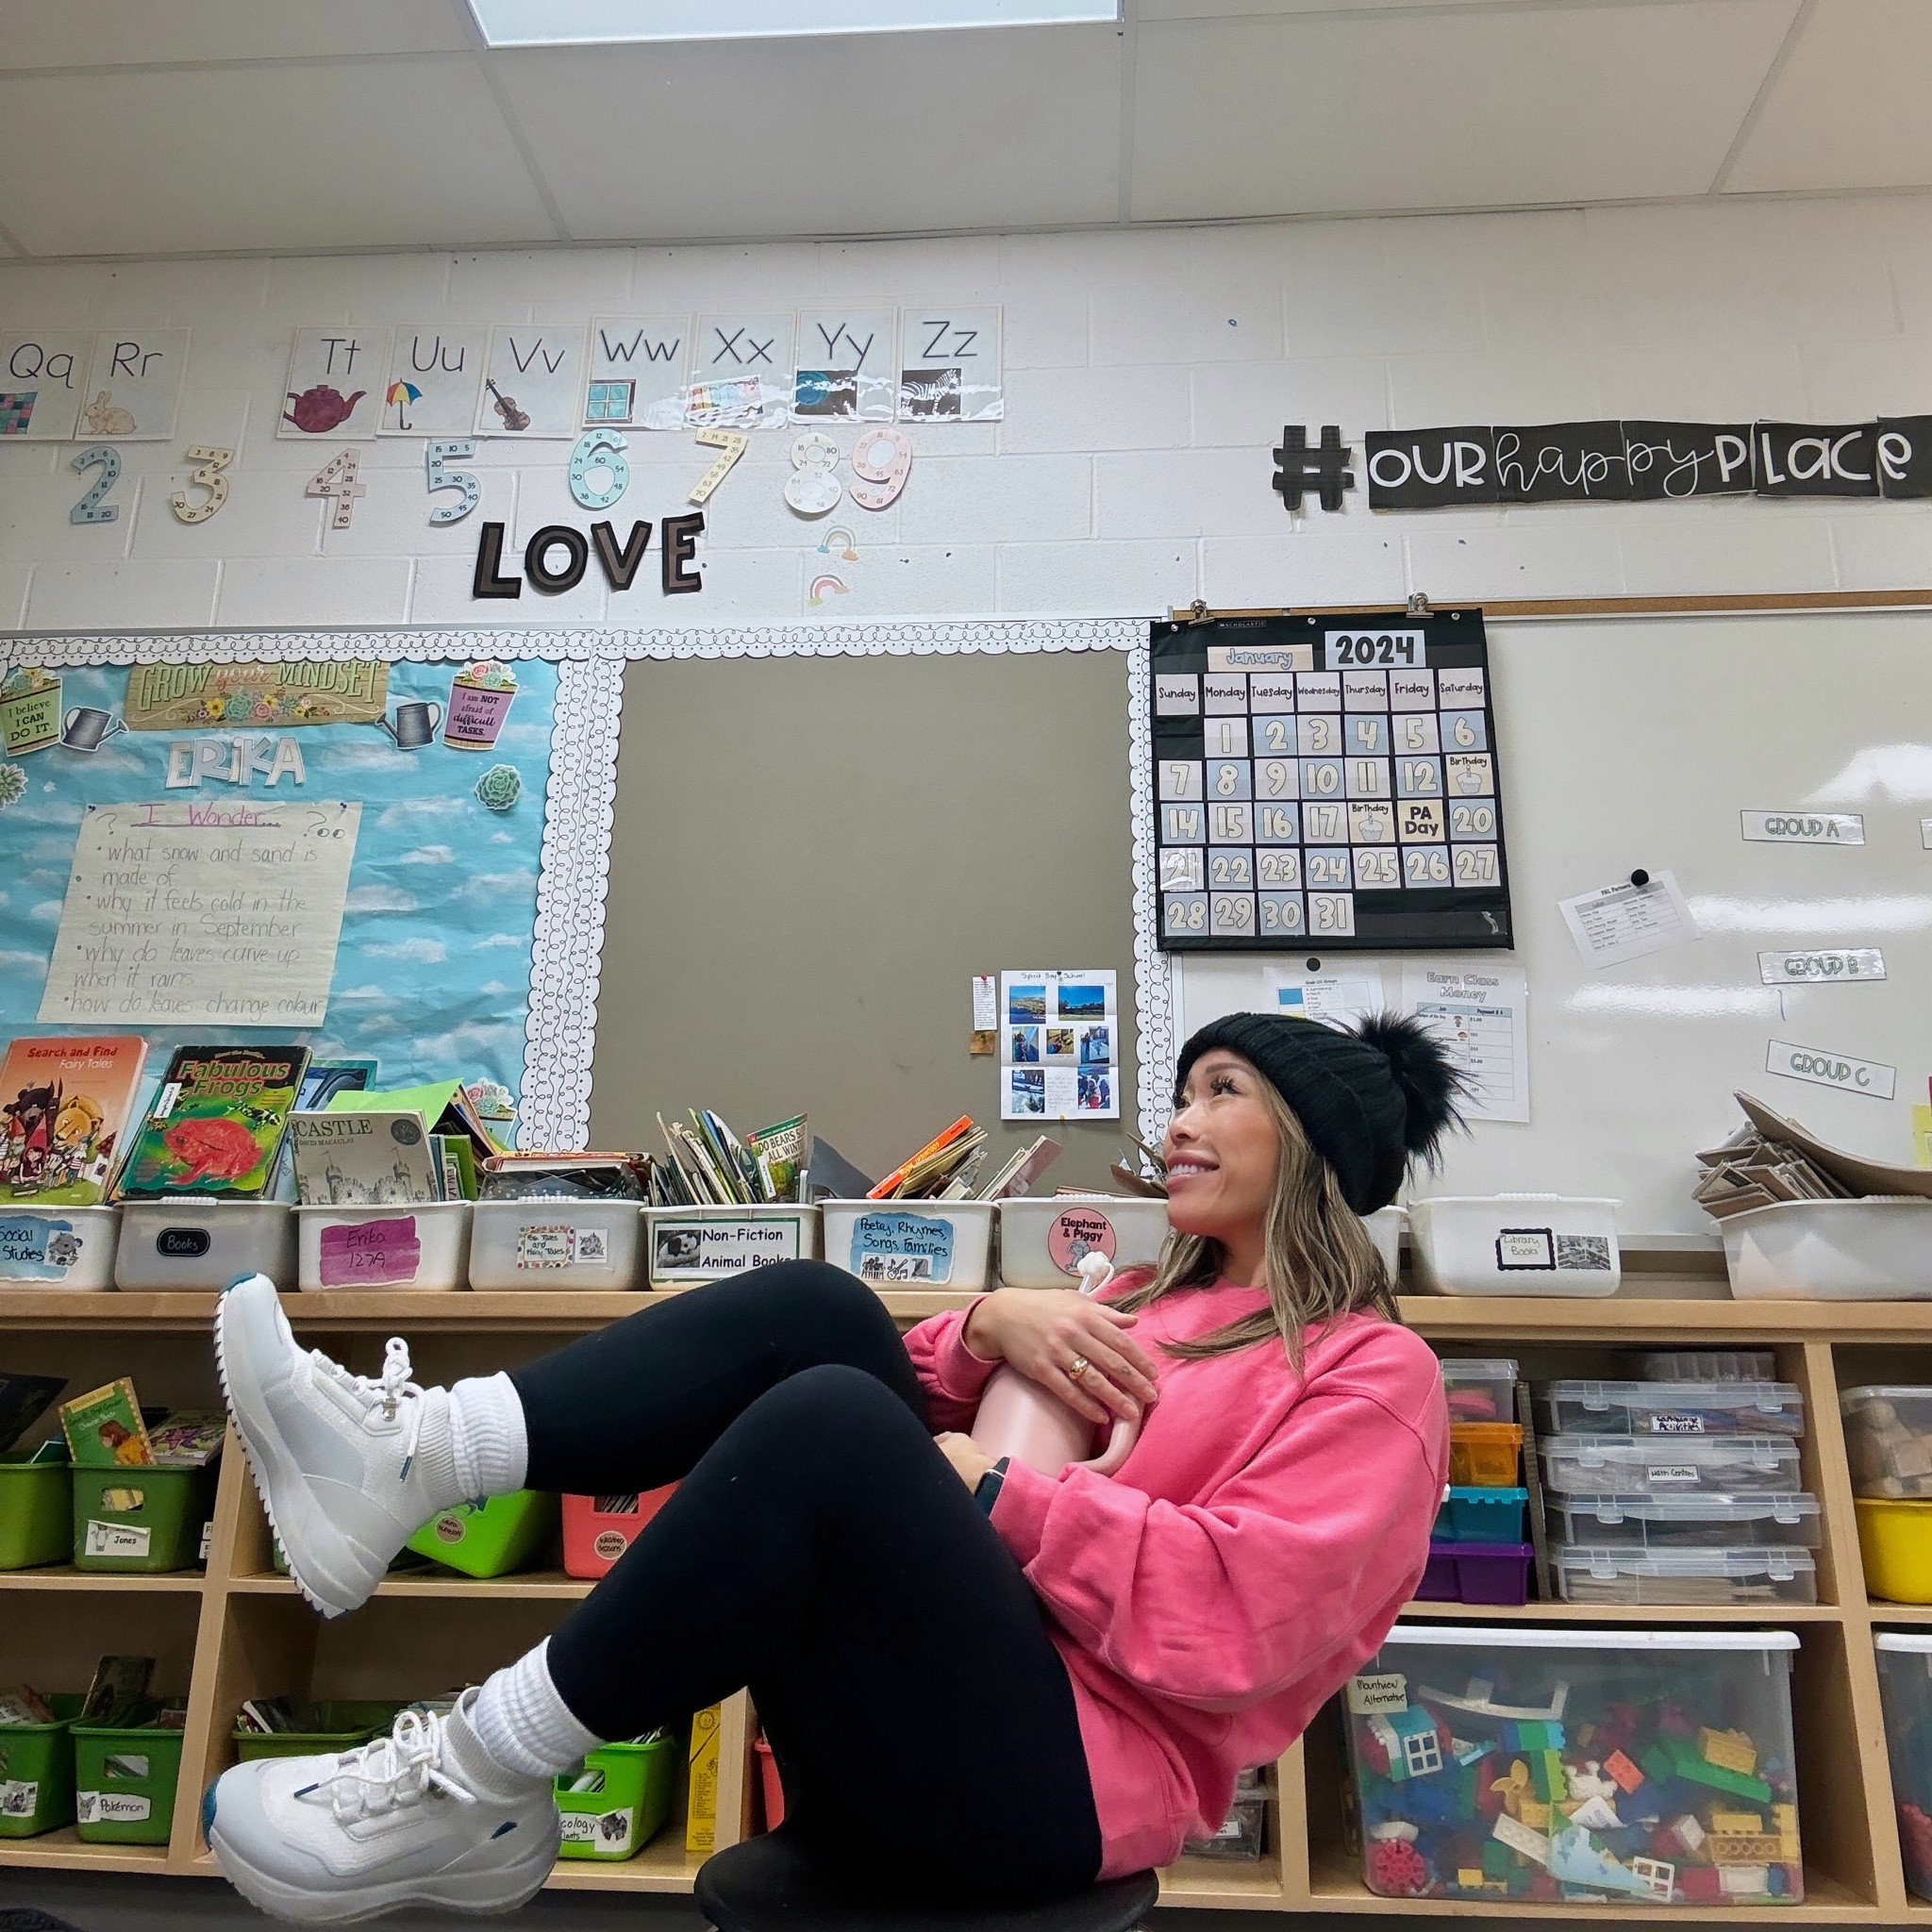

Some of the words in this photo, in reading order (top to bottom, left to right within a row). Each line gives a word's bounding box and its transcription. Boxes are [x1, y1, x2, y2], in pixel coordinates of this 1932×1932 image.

[600, 328, 680, 362] Ww
[712, 327, 772, 364] Xx
[817, 323, 874, 369] Yy
[922, 321, 978, 358] Zz
[9, 343, 75, 389] Qq
[110, 342, 163, 376] Rr
[321, 338, 361, 375] Tt
[411, 336, 465, 374] Uu
[509, 337, 566, 374] Vv
[569, 429, 629, 509] 6
[687, 428, 748, 504] 7
[785, 431, 842, 513] 8
[849, 429, 912, 509] 9
[1369, 441, 1485, 488] OUR
[1496, 433, 1715, 496] happy
[71, 446, 121, 524] 2
[172, 446, 235, 524] 3
[307, 448, 366, 527] 4
[426, 440, 480, 523] 5
[474, 512, 705, 598] LOVE
[1226, 648, 1292, 670] January
[1336, 635, 1414, 664] 2024
[139, 665, 213, 711] GROW
[215, 665, 272, 691] your
[275, 661, 381, 703] MINDSET
[1159, 688, 1195, 701] Sunday
[1206, 687, 1245, 700] Monday
[1252, 686, 1292, 700] Tuesday
[1298, 687, 1340, 696] Wednesday
[1345, 685, 1385, 696] Thursday
[1394, 683, 1429, 697] Friday
[1441, 683, 1483, 694] Saturday
[8, 708, 13, 717] I
[16, 700, 51, 715] believe
[461, 705, 483, 713] afraid
[481, 695, 499, 704] NOT
[23, 712, 44, 724] CAN
[454, 714, 495, 726] difficult
[10, 728, 30, 741] DO
[35, 723, 53, 733] IT.
[458, 726, 485, 736] TASKS.
[1222, 724, 1231, 753] 1
[1266, 721, 1287, 750] 2
[1310, 720, 1328, 749] 3
[1357, 720, 1378, 749] 4
[1407, 718, 1424, 748] 5
[1454, 717, 1475, 746] 6
[1450, 757, 1487, 768] Birthday
[1170, 765, 1190, 795] 7
[1217, 765, 1238, 795] 8
[1266, 765, 1286, 795] 9
[1307, 763, 1338, 792] 10
[1358, 761, 1377, 791] 11
[1404, 761, 1437, 791] 12
[139, 804, 165, 824] I
[1352, 804, 1389, 814] Birthday
[1410, 807, 1432, 820] PA
[1169, 808, 1198, 838] 14
[1217, 807, 1242, 838] 15
[1262, 808, 1293, 838] 16
[1310, 807, 1338, 837] 17
[1405, 822, 1439, 838] Day
[1453, 808, 1492, 833] 20
[1765, 818, 1823, 836] GROUP
[1826, 821, 1840, 837] A
[108, 838, 152, 861] what
[162, 847, 199, 860] snow
[209, 840, 240, 861] and
[252, 839, 295, 862] sand
[304, 844, 317, 861] is
[103, 866, 147, 885] made
[157, 864, 179, 887] of
[1212, 855, 1250, 884] 22
[1260, 855, 1296, 882] 23
[1309, 855, 1347, 882] 24
[1358, 852, 1397, 881] 25
[1407, 852, 1448, 880] 26
[1457, 851, 1495, 879] 27
[97, 891, 131, 920] why
[145, 891, 157, 911] it
[166, 889, 203, 911] feels
[211, 891, 242, 911] cold
[253, 895, 268, 911] in
[279, 889, 308, 911] the
[1168, 901, 1207, 929] 28
[1215, 897, 1252, 927] 29
[1262, 900, 1301, 927] 30
[1320, 898, 1346, 928] 31
[91, 921, 162, 936] summer
[172, 919, 187, 936] in
[200, 913, 304, 944] September
[86, 937, 124, 965] why
[133, 940, 158, 961] do
[171, 938, 214, 961] leaves
[223, 947, 269, 962] curve
[277, 949, 299, 968] up
[75, 968, 116, 988] when
[126, 966, 139, 986] it
[152, 974, 194, 986] rains
[1427, 972, 1458, 984] Earn
[1464, 974, 1499, 986] Class
[1441, 987, 1487, 1003] Money
[71, 991, 110, 1012] how
[120, 991, 142, 1013] do
[148, 992, 192, 1013] leaves
[207, 991, 269, 1023] change
[27, 1047, 66, 1058] Search
[70, 1047, 91, 1057] and
[94, 1046, 118, 1056] Find
[59, 1059, 84, 1070] Fairy
[87, 1059, 113, 1069] Tales
[176, 1060, 291, 1081] Fabulous
[1790, 1053, 1851, 1082] GROUP
[1856, 1068, 1870, 1087] C
[192, 1079, 265, 1098] Frogs
[297, 1119, 373, 1137] CASTLE
[758, 1141, 769, 1153] DO
[770, 1131, 795, 1148] BEARS
[769, 1149, 783, 1161] ALL
[703, 1228, 783, 1241] Non-Fiction
[898, 1222, 947, 1241] Rhymes,
[1061, 1218, 1107, 1230] Elephant
[1063, 1228, 1070, 1238] &
[1074, 1229, 1103, 1242] Piggy
[167, 1236, 198, 1251] Books
[346, 1228, 386, 1248] Erika
[904, 1238, 948, 1257] Families
[3, 1247, 44, 1261] Studies
[702, 1255, 745, 1268] Animal
[114, 1536, 136, 1544] Jones
[101, 1798, 143, 1812] Pokémon
